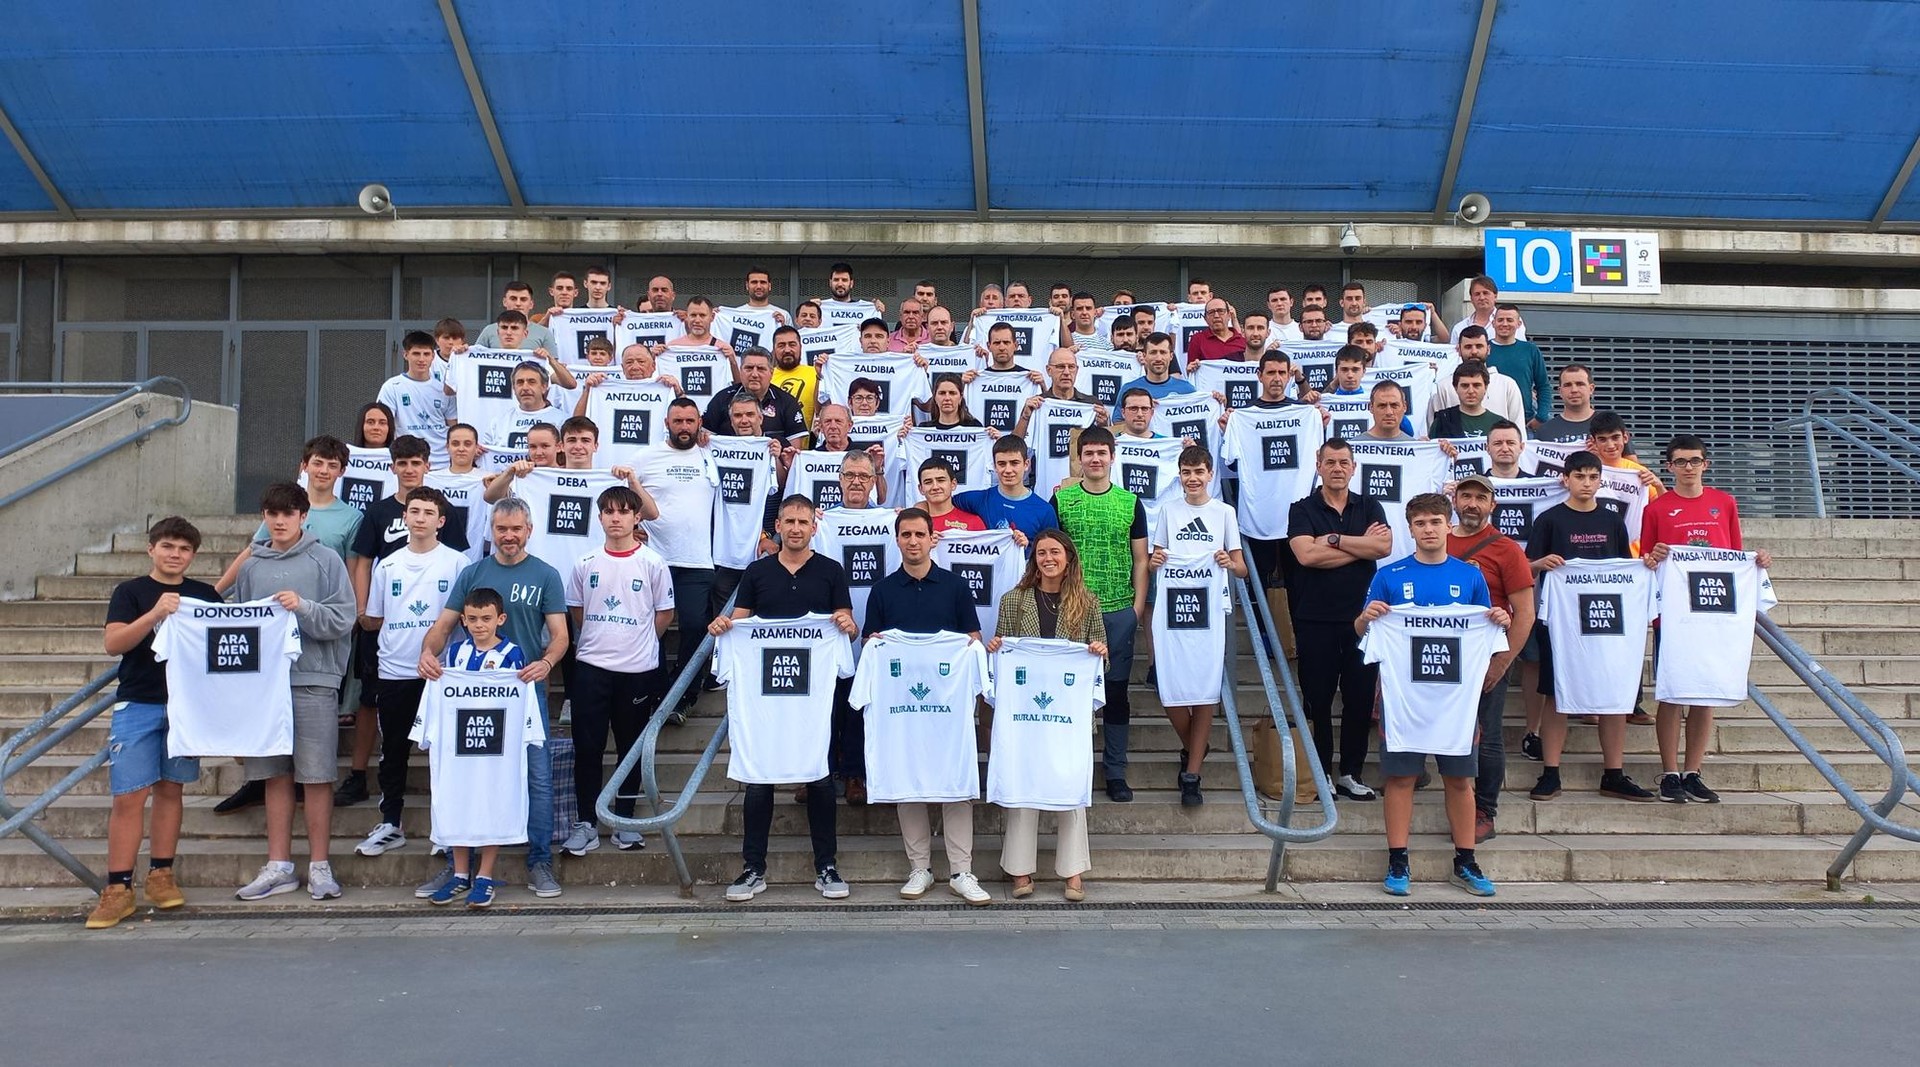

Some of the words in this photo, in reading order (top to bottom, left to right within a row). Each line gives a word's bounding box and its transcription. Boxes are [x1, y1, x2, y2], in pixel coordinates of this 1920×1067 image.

[1496, 237, 1561, 284] 10
[831, 311, 864, 319] LAZKAO
[627, 322, 674, 330] OLABERRIA
[733, 316, 765, 329] LAZKAO
[737, 334, 753, 342] ARA
[802, 335, 837, 344] ORDIZIA
[468, 352, 523, 361] AMEZKETA
[1293, 351, 1337, 360] ZUMARRAG
[1398, 348, 1448, 359] ZUMARRAGA
[676, 354, 718, 363] BERGARA
[929, 358, 968, 366] ZALDIBIA
[854, 364, 895, 374] ZALDIBIA
[1083, 360, 1132, 370] LASARTE-ORIA
[486, 370, 506, 378] ARA
[1309, 374, 1328, 382] MEN
[1375, 371, 1413, 380] ANOETA
[485, 378, 506, 386] MEN
[1098, 379, 1115, 387] ARA
[981, 384, 1022, 393] ZALDIBIA
[605, 393, 662, 402] ANTZUOLA
[1165, 404, 1211, 416] AZKOITIA
[1328, 403, 1370, 412] ALBIZTU
[990, 411, 1010, 419] MEN
[1048, 408, 1083, 418] ALEGIA
[622, 415, 642, 423] ARA
[1255, 418, 1301, 430] ALBIZTUR
[848, 425, 888, 434] ALDIBIA
[1181, 425, 1199, 433] ARA
[620, 430, 638, 438] DIA
[924, 433, 976, 443] OIARTZUN
[1270, 441, 1289, 449] ARA
[712, 449, 764, 460] OIARTZUN
[1121, 446, 1160, 458] ZESTOA
[1270, 448, 1291, 456] MEN
[1270, 456, 1287, 464] DIA
[347, 458, 393, 472] NDOAIN
[805, 463, 841, 473] OIARTZ
[1455, 463, 1475, 472] ARA
[723, 472, 744, 482] ARA
[1130, 469, 1149, 478] ARA
[1370, 470, 1393, 479] ARA
[557, 476, 588, 488] DEBA
[723, 481, 745, 490] MEN
[1129, 477, 1150, 485] MEN
[1370, 479, 1394, 487] MEN
[351, 483, 374, 493] ARA
[820, 486, 841, 494] ARA
[1129, 485, 1145, 493] DIA
[1369, 488, 1388, 496] DIA
[1494, 488, 1548, 497] RENTERIA
[349, 492, 374, 502] MEN
[438, 487, 468, 499] ÑATI
[723, 490, 739, 498] DIA
[820, 494, 842, 502] MEN
[558, 501, 582, 511] ARA
[557, 511, 582, 519] MEN
[1500, 510, 1524, 518] ARA
[556, 520, 575, 529] DIA
[1500, 518, 1525, 526] MEN
[838, 525, 890, 536] ZEGAMA
[1500, 527, 1520, 535] DIA
[1687, 529, 1708, 537] ARGI
[1176, 531, 1214, 542] adidas
[948, 543, 1000, 556] ZEGAMA
[852, 552, 876, 561] ARA
[1672, 551, 1747, 562] AMASA-VILLABONA
[852, 561, 877, 570] MEN
[852, 571, 872, 580] DIA
[1164, 568, 1213, 579] ZEGAMA
[1565, 573, 1634, 585] AMASA-VILLABONA
[1699, 578, 1724, 587] ARA
[968, 580, 984, 589] EN
[1699, 587, 1726, 596] MEN
[1176, 594, 1199, 603] ARA
[1699, 596, 1722, 605] DIA
[1176, 603, 1201, 612] MEN
[1589, 600, 1614, 609] ARA
[194, 606, 274, 618] DONOSTIA
[1589, 609, 1615, 618] MEN
[608, 615, 638, 626] KUTXA
[1176, 613, 1196, 622] DIA
[389, 620, 416, 630] RURAL
[419, 620, 437, 628] KUT
[1404, 616, 1469, 629] HERNANI
[1589, 619, 1611, 628] DIA
[750, 628, 823, 639] ARAMENDIA
[218, 634, 247, 644] ARA
[218, 644, 249, 655] MEN
[1423, 644, 1450, 653] ARA
[218, 656, 242, 666] DIA
[773, 655, 799, 665] ARA
[1422, 654, 1451, 664] MEN
[772, 666, 800, 676] MEN
[1422, 665, 1445, 675] DIA
[772, 677, 794, 687] DIA
[444, 686, 520, 698] OLABERRIA
[889, 705, 918, 714] RURAL
[920, 705, 951, 713] KUTXA
[467, 716, 494, 726] ARA
[1013, 713, 1040, 722] RURAL
[1042, 714, 1072, 724] KUTXA
[466, 727, 494, 737] MEN
[466, 738, 487, 748] DIA
